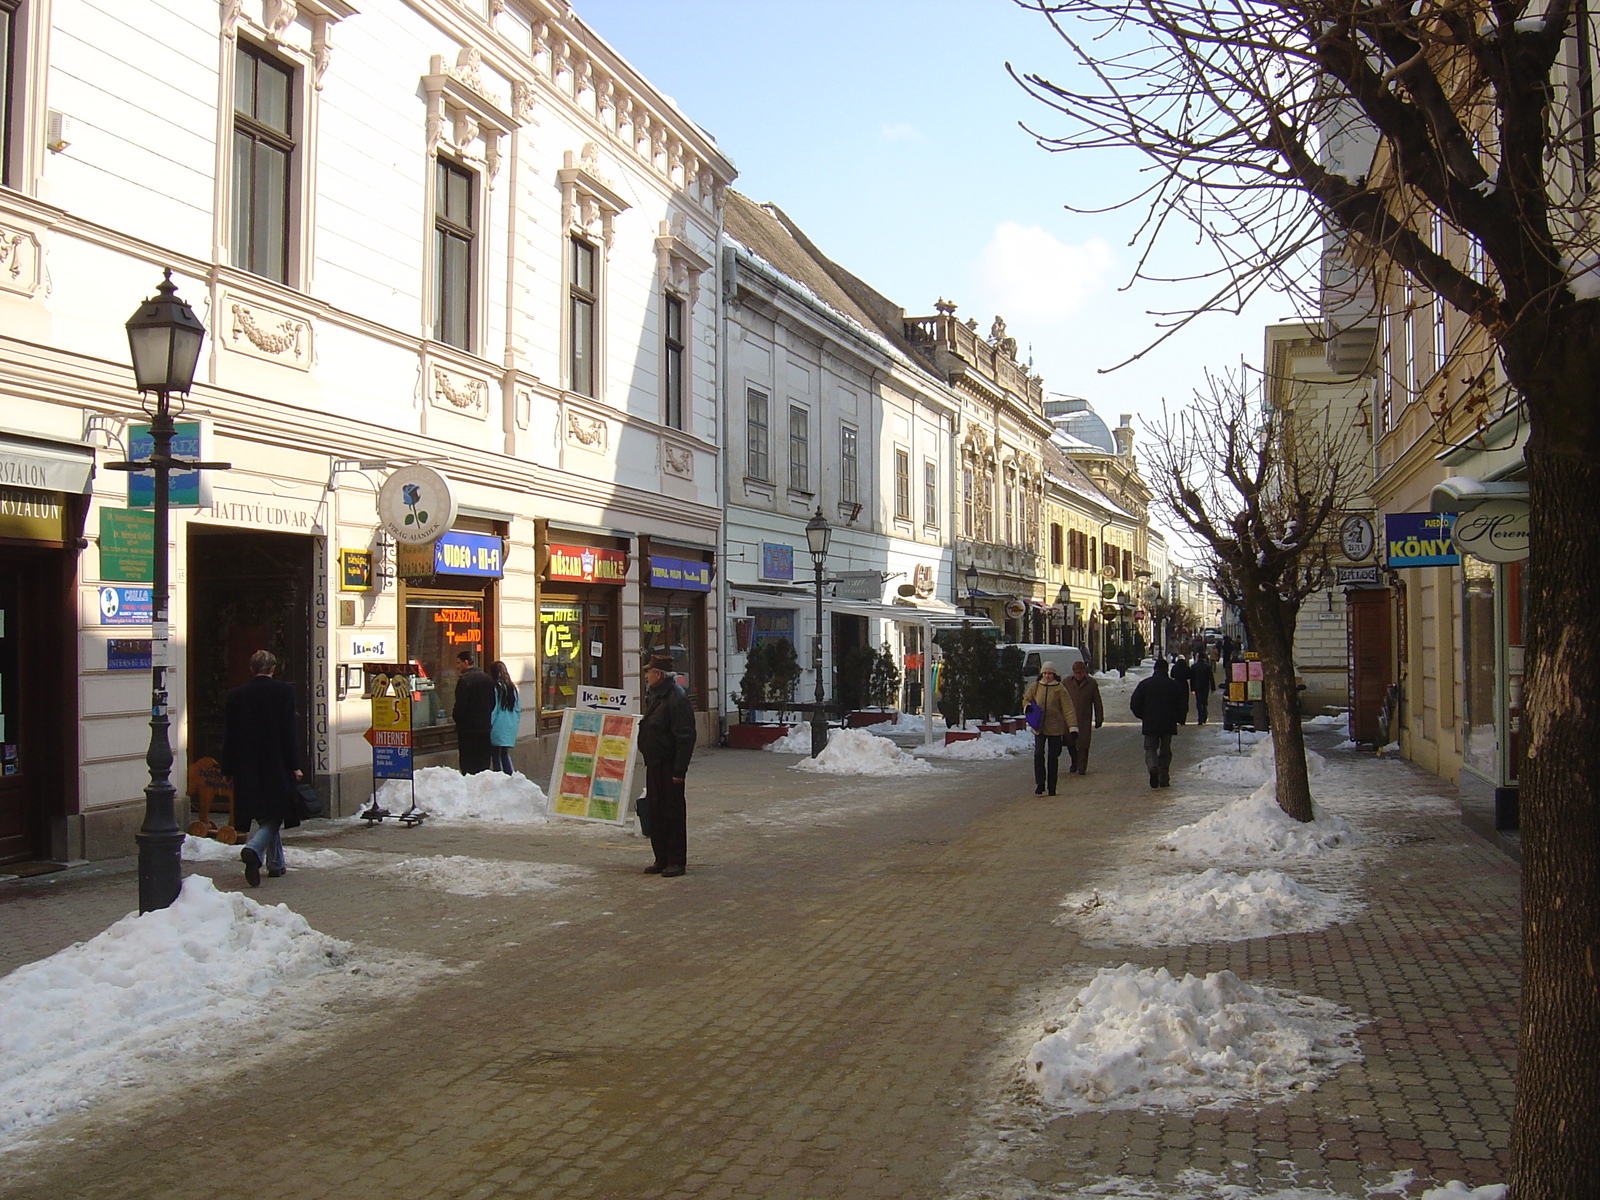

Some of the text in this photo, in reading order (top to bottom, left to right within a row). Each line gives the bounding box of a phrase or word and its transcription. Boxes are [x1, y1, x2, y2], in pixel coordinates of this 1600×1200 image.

[131, 439, 199, 455] MARIX
[210, 501, 308, 528] HATTYÚ UDVAR
[443, 544, 500, 571] VIDEO HI-FI
[364, 664, 417, 674] MATRIX
[375, 731, 409, 746] INTERNET
